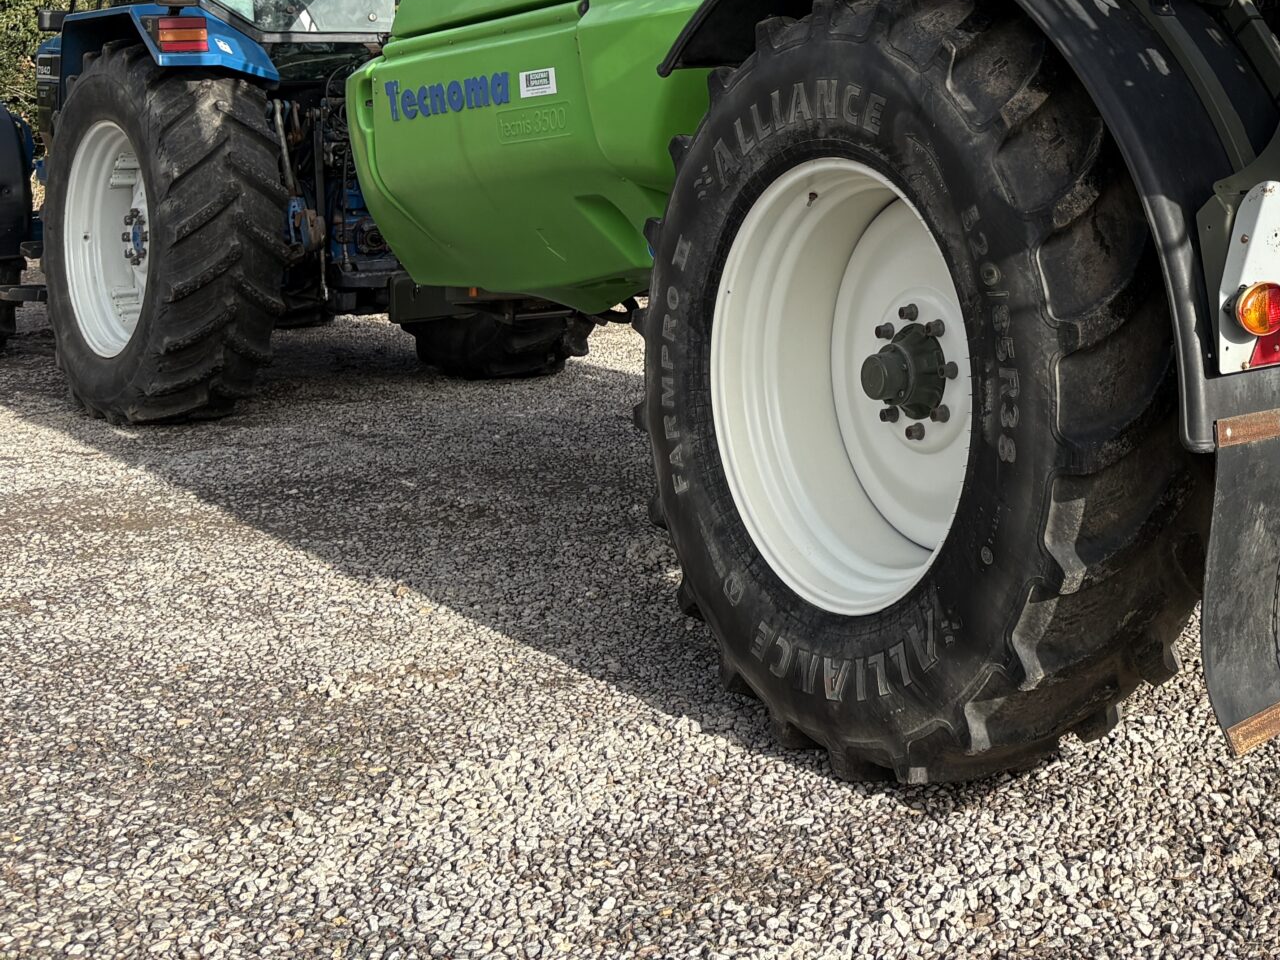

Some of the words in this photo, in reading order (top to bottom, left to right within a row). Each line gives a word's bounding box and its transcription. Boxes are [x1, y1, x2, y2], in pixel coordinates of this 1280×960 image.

[384, 71, 510, 122] Tecnoma
[533, 106, 567, 133] 3500
[713, 79, 888, 191] ALLIANCE
[660, 286, 690, 495] FARMPRO
[751, 607, 940, 702] ALLIANCE
